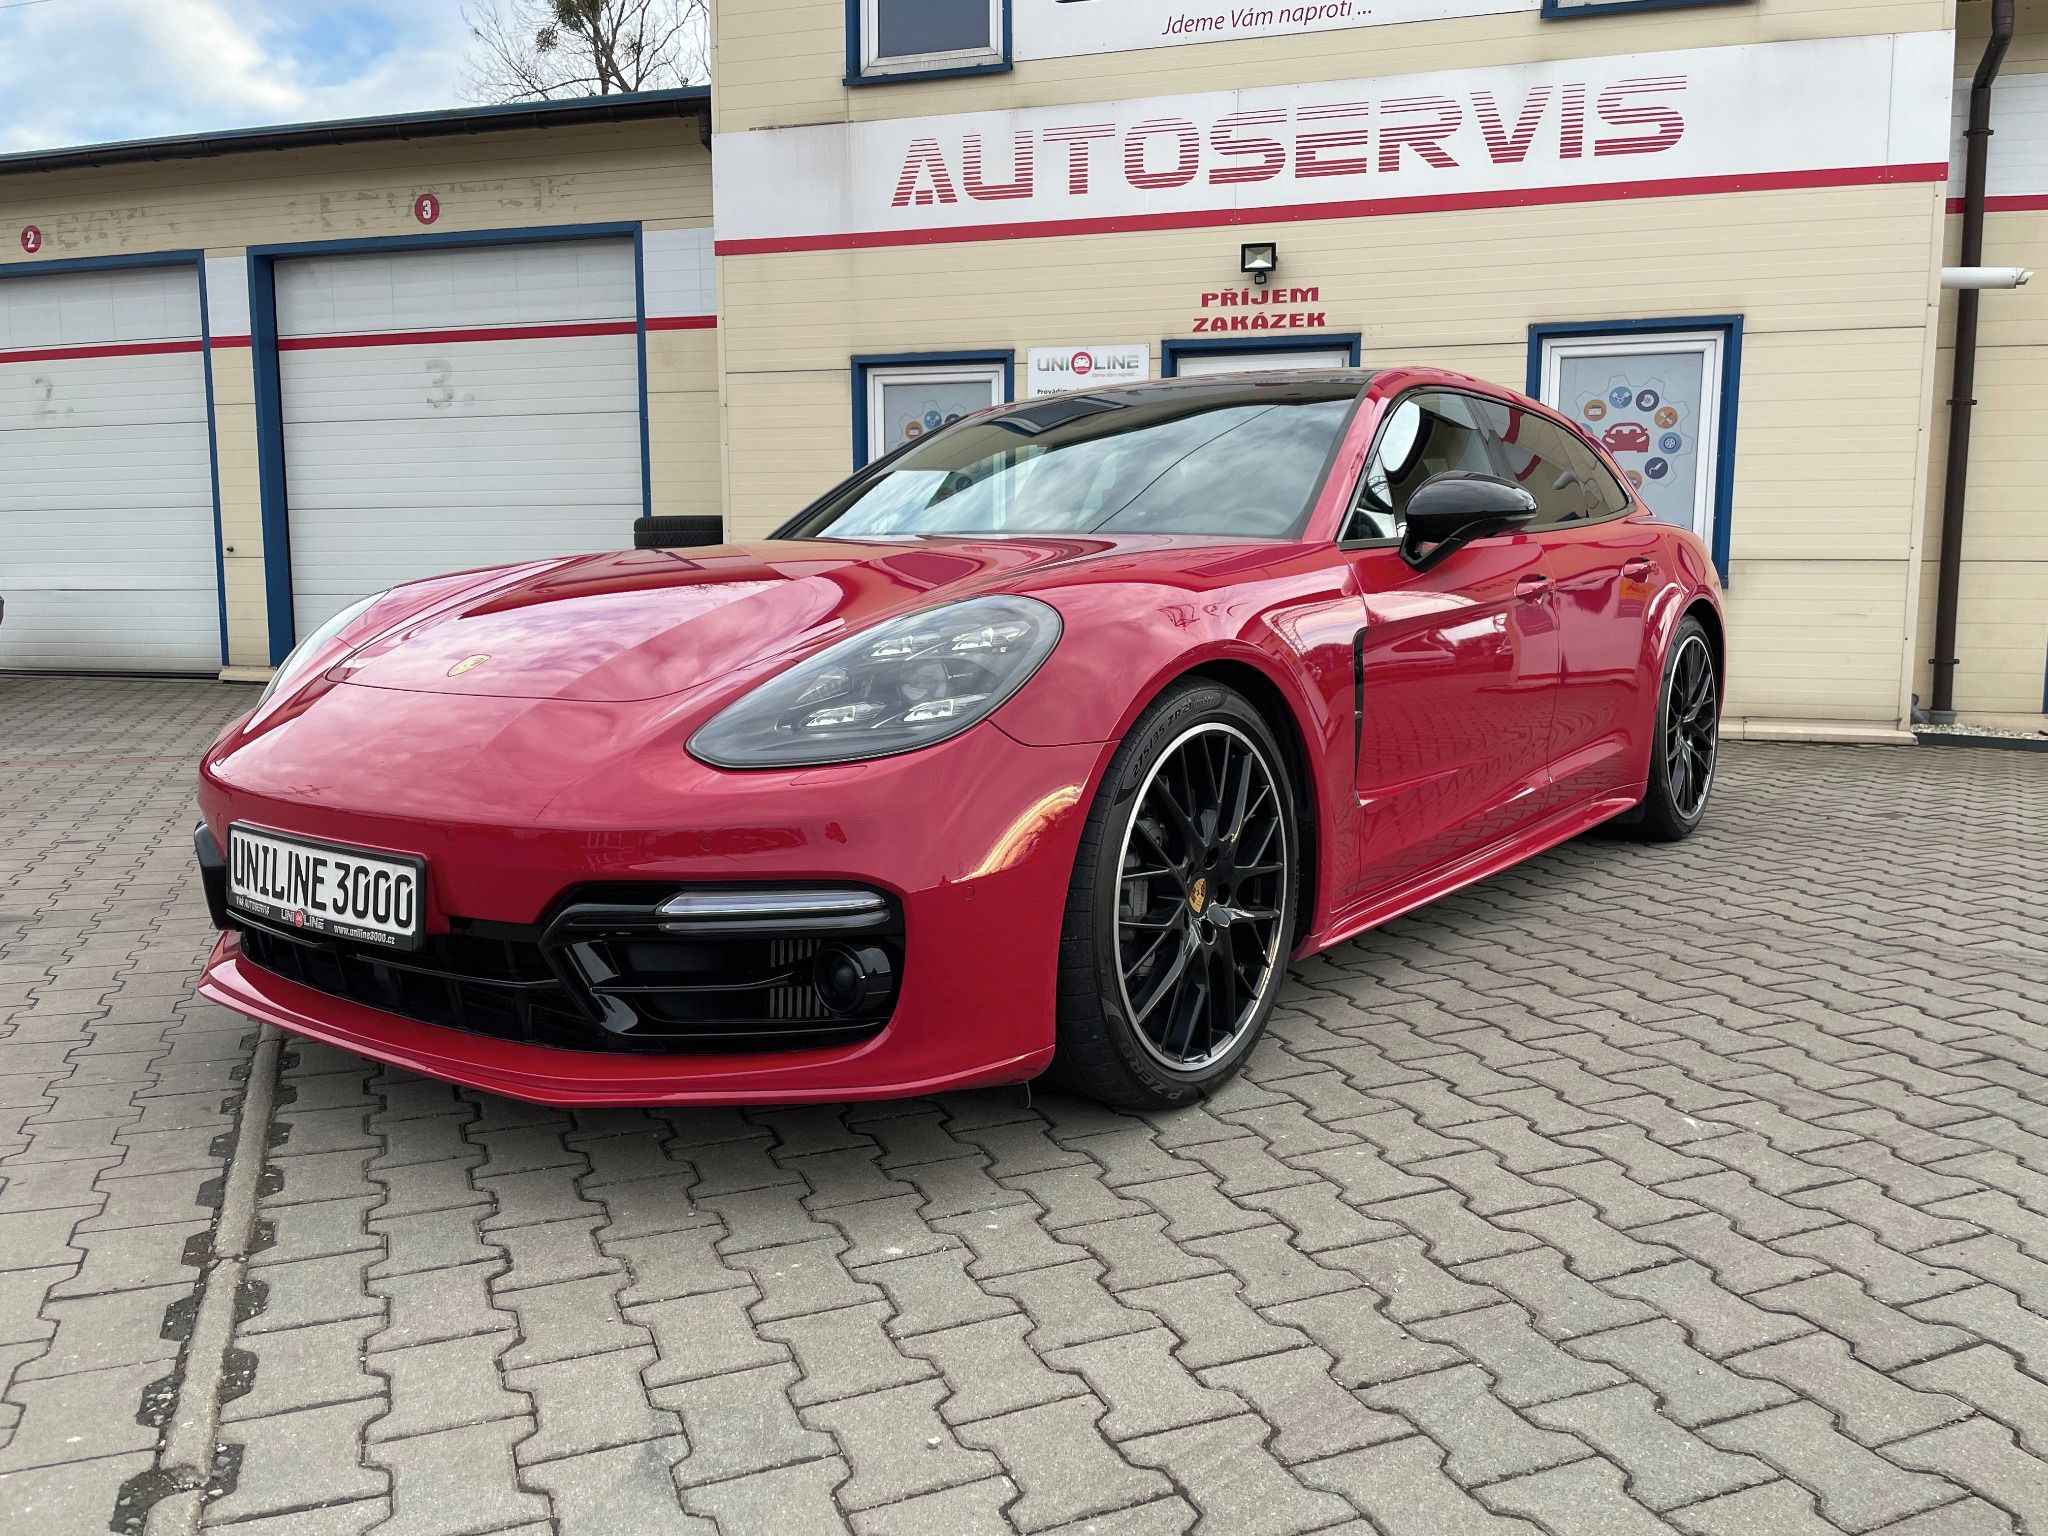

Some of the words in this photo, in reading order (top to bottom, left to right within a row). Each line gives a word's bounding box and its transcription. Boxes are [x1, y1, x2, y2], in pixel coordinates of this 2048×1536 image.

[1162, 14, 1225, 35] Jdeme
[1231, 8, 1273, 29] Vám
[1279, 0, 1353, 26] naproti
[891, 75, 1688, 207] AUTOSERVIS
[422, 200, 433, 219] 3
[26, 231, 35, 248] 2
[1201, 286, 1319, 307] PŘÍJEM
[1192, 312, 1326, 333] ZAKÁZEK
[333, 925, 396, 945] www.uniline3000.cz
